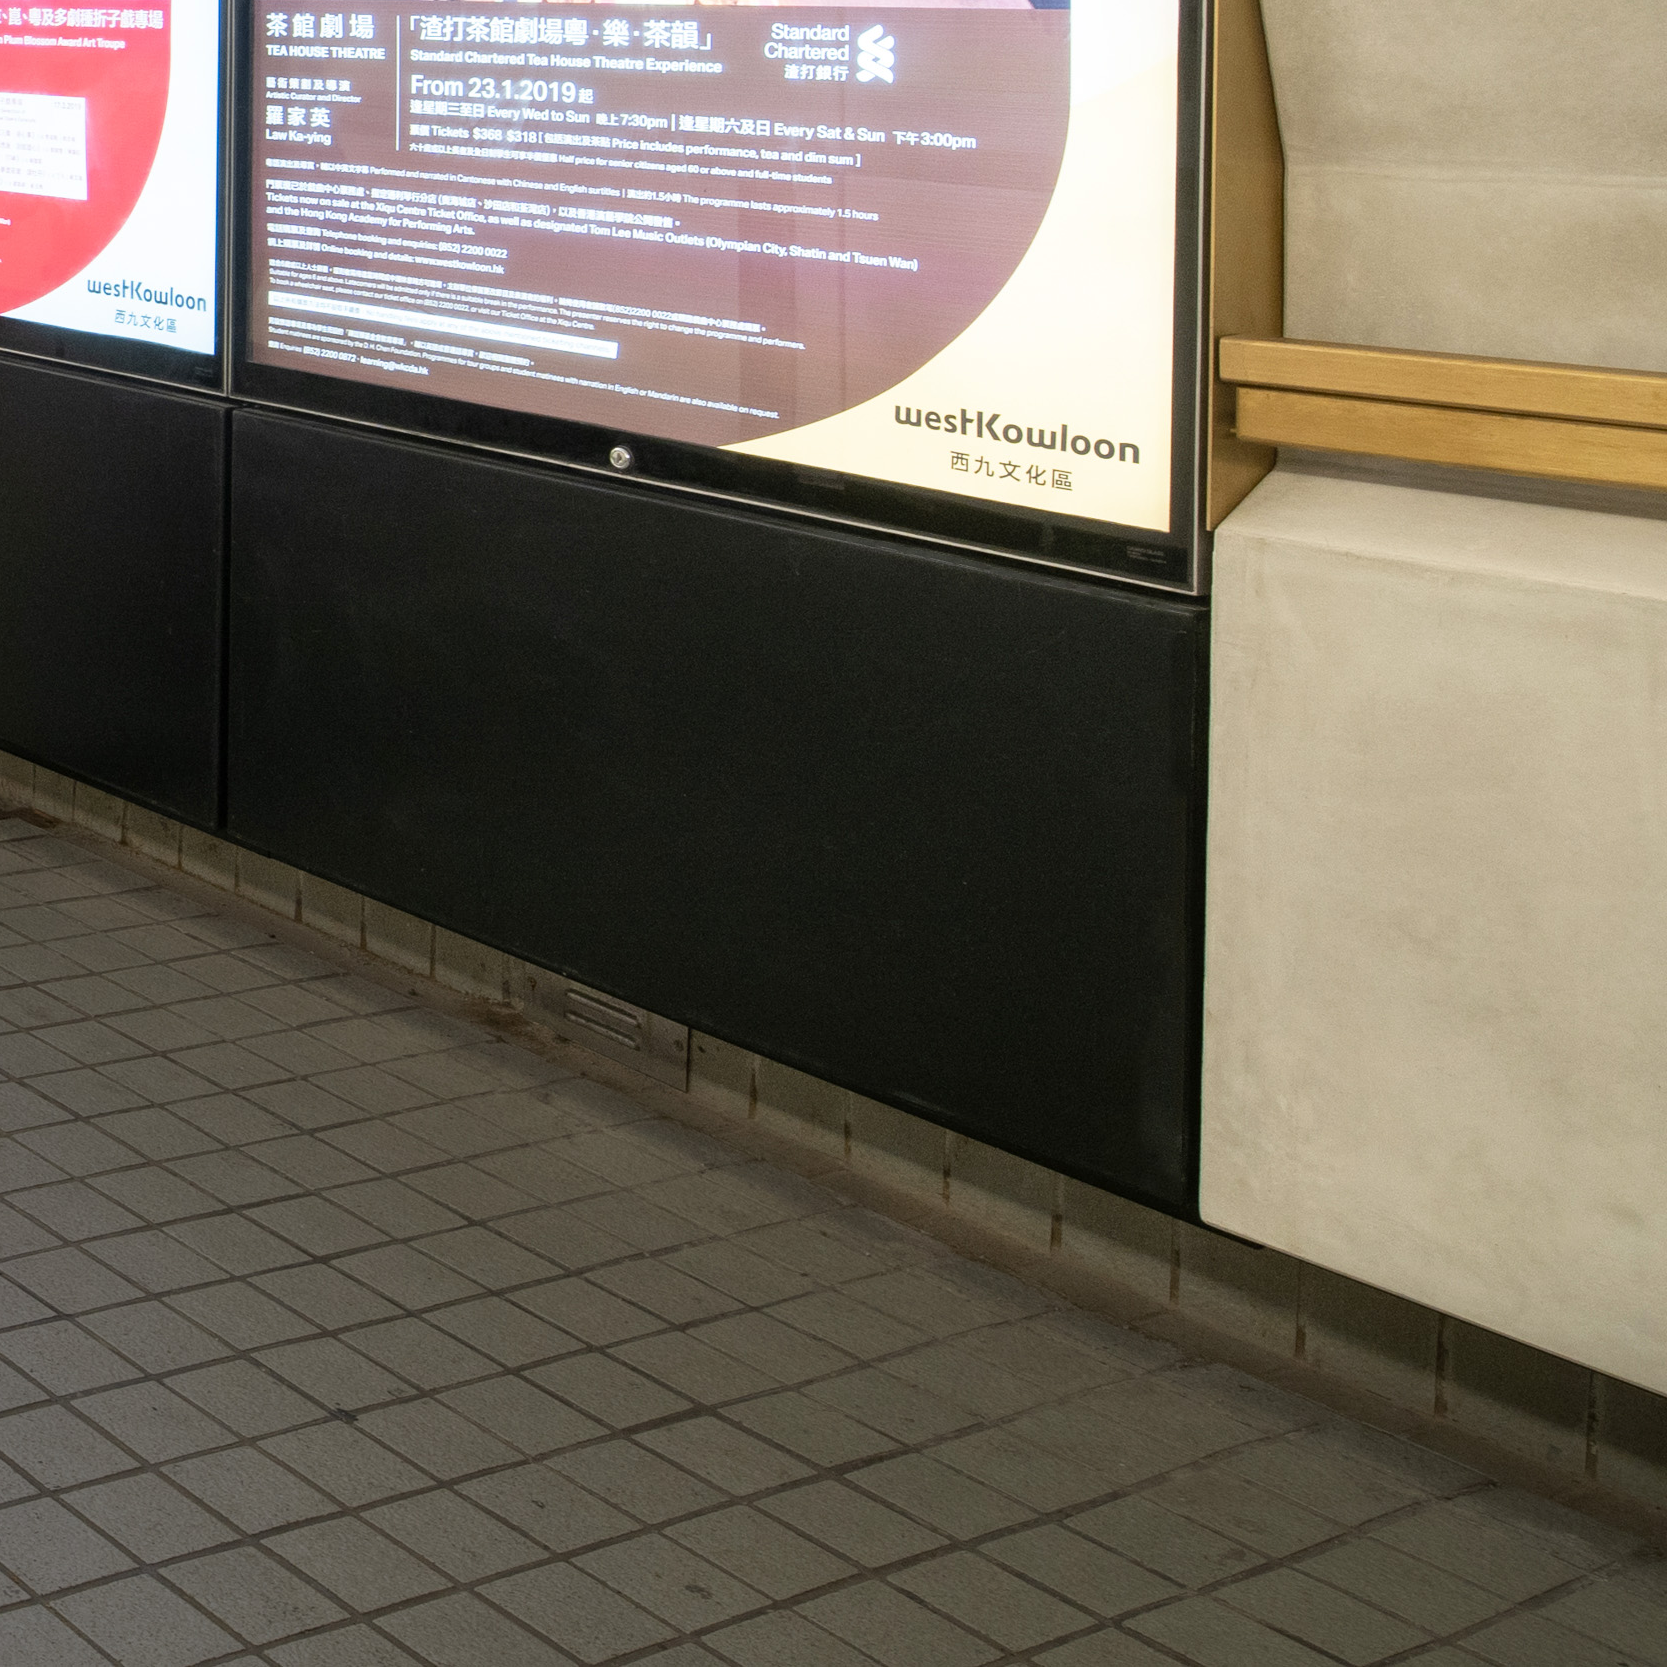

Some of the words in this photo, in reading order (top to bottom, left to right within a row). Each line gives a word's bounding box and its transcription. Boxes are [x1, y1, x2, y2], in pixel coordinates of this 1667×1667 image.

[266, 12, 375, 39] 茶館劇場
[771, 23, 850, 41] Standard
[265, 44, 288, 56] TEA
[289, 45, 329, 58] HOUSE
[330, 47, 386, 59] THEATRE
[410, 49, 463, 63] Standard
[464, 51, 525, 65] Chartered
[526, 53, 549, 66] Tea
[550, 54, 591, 68] House
[592, 56, 644, 70] Theatre
[646, 58, 722, 73] Experience
[764, 42, 849, 61] Chartered
[784, 64, 849, 81] 渣打銀行
[411, 75, 463, 96] From
[468, 77, 576, 103] 23.1.2019
[266, 105, 330, 128] 羅家英
[487, 105, 521, 121] Every
[521, 107, 552, 121] Wed
[550, 110, 564, 121] to
[565, 110, 590, 123] Sun
[774, 123, 815, 140] Every
[816, 125, 842, 139] Sat
[843, 127, 855, 140] &
[857, 127, 885, 142] Sun
[266, 128, 288, 140] Law
[288, 130, 331, 146] Ka-ying
[431, 125, 470, 138] Tickets
[472, 127, 502, 141] $368
[505, 129, 537, 143] $318
[612, 138, 639, 149] Price
[640, 140, 685, 153] includes
[760, 149, 779, 160] tea
[780, 151, 803, 162] and
[804, 152, 827, 163] dim
[265, 192, 299, 203] Tickets
[299, 196, 319, 205] now
[319, 198, 332, 206] on
[332, 198, 350, 208] sale
[350, 200, 360, 209] at
[358, 201, 375, 211] the
[375, 202, 396, 214] Xiqu
[396, 204, 427, 216] Centre
[427, 207, 456, 219] Ticket
[456, 210, 487, 223] Office,
[487, 215, 500, 224] as
[500, 216, 520, 226] well
[520, 219, 533, 227] as
[533, 219, 588, 233] designated
[589, 224, 611, 236] Tom
[612, 226, 631, 238] Lee
[632, 228, 664, 242] Music
[665, 232, 705, 246] Outlets
[705, 236, 761, 252] (Olympian
[762, 242, 788, 257] City,
[789, 245, 827, 259] Shatin
[827, 251, 851, 262] and
[852, 252, 887, 267] Tsuen
[888, 256, 918, 272] Wan)
[266, 205, 283, 214] and
[284, 206, 300, 216] the
[300, 207, 324, 220] Hong
[325, 210, 348, 223] Kong
[348, 212, 388, 227] Academy
[387, 216, 402, 227] for
[402, 218, 452, 235] Performing
[452, 224, 475, 235] Arts.
[87, 280, 206, 311] westKowloon
[115, 309, 176, 333] 西九文化區
[895, 405, 1140, 464] westKowloon
[951, 451, 1072, 491] 西九文化區
